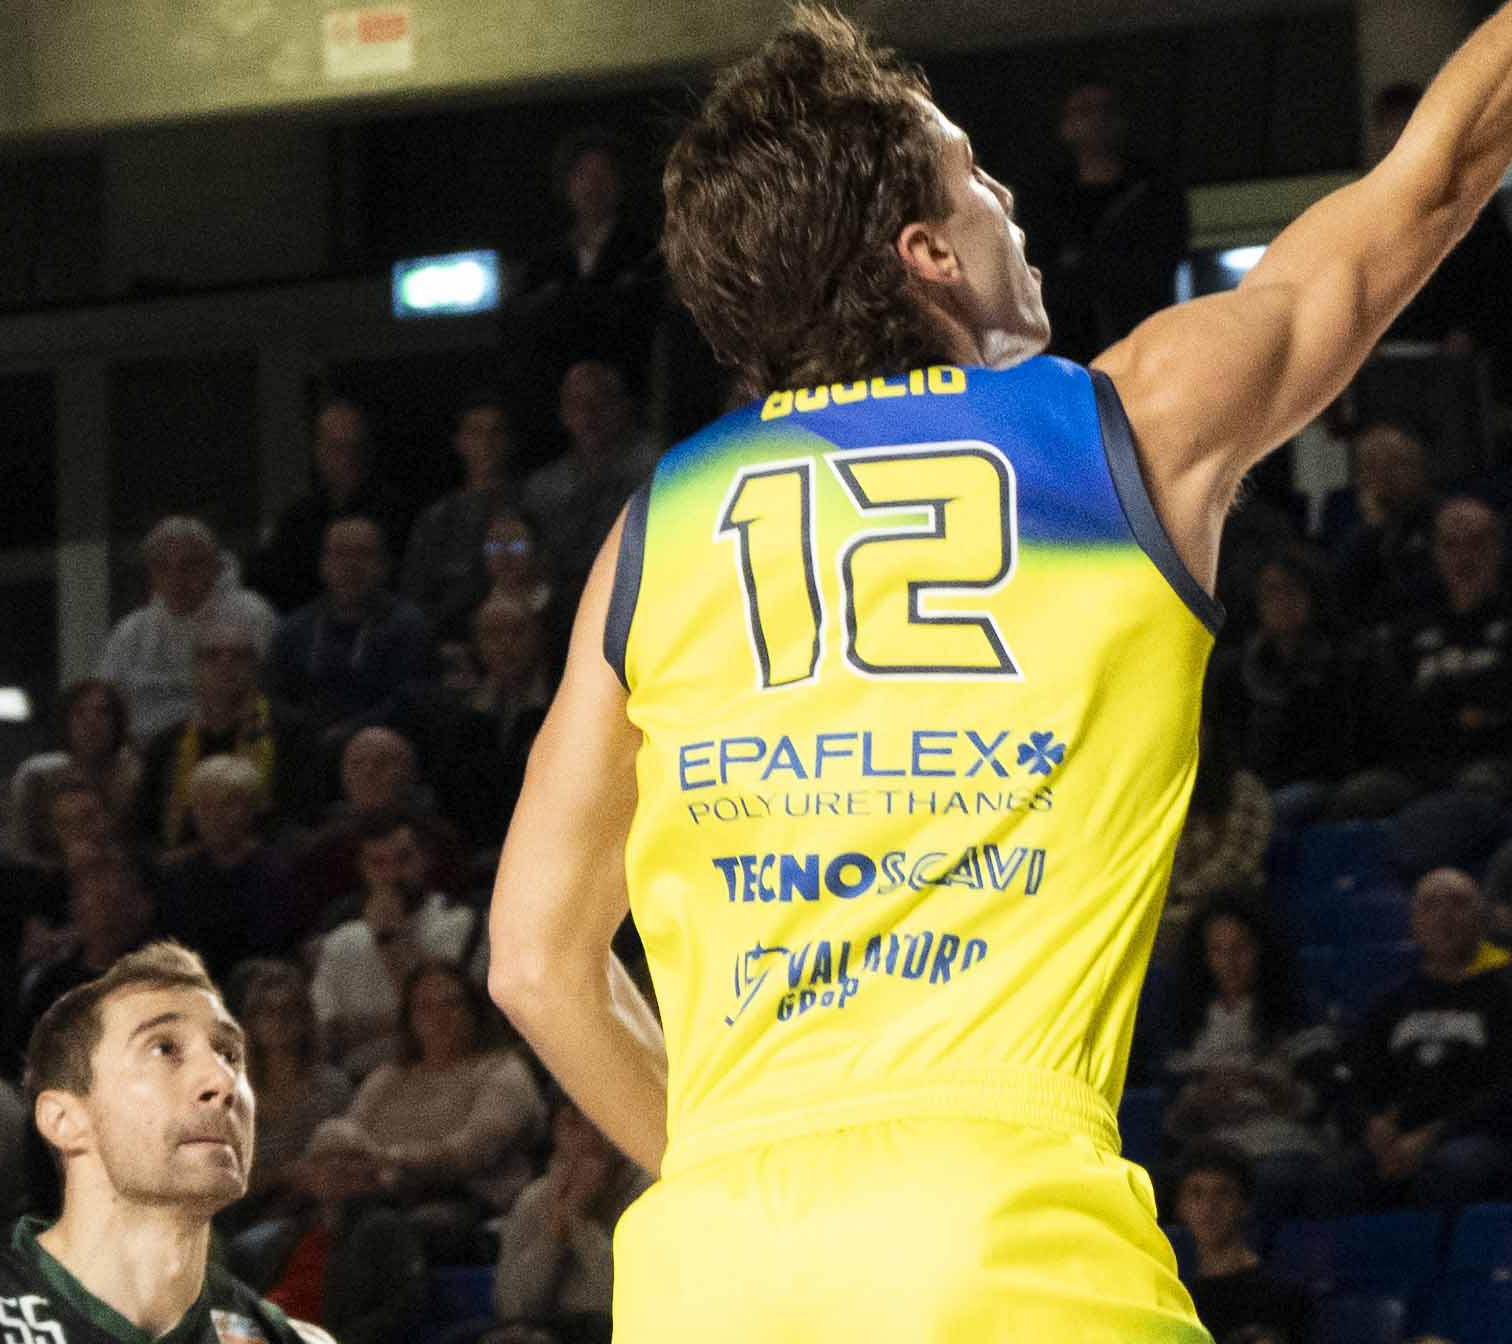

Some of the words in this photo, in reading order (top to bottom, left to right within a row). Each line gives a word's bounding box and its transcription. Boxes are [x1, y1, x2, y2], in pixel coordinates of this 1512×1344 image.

[712, 440, 1025, 692] 12
[679, 730, 1014, 791] EPAFLEX
[687, 786, 1054, 824] POLYURETHANES
[712, 843, 1046, 903] TECNOSCAVI
